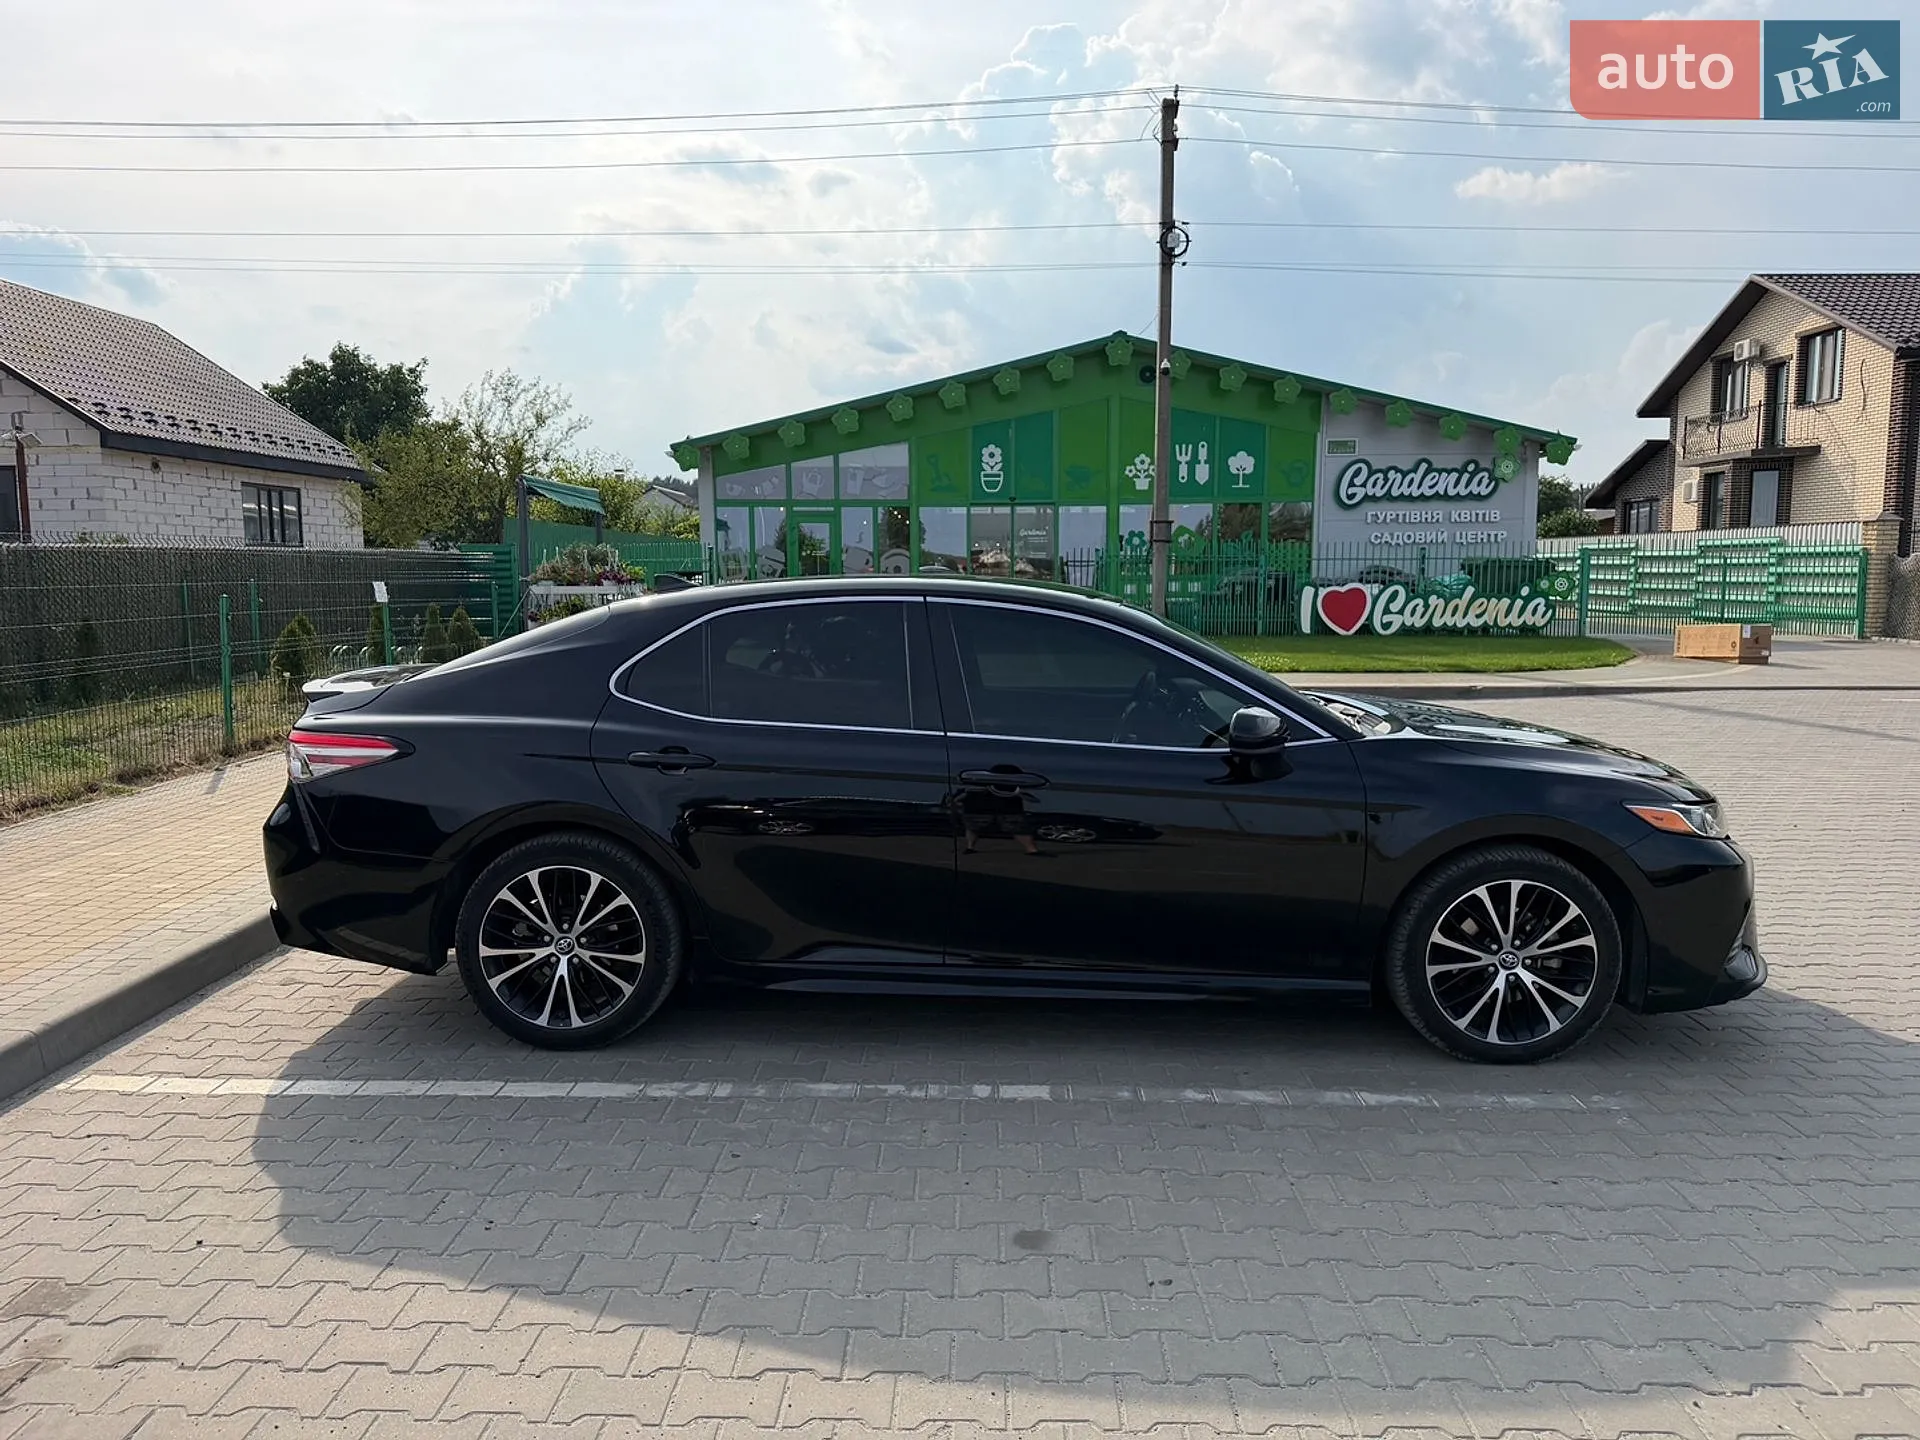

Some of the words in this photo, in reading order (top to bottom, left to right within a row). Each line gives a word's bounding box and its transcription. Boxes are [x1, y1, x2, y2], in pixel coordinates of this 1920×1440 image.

[1339, 462, 1495, 505] Gardenia
[1366, 510, 1444, 524] ГУРТІВНЯ
[1450, 509, 1501, 523] КВІТІВ
[1370, 529, 1448, 545] САДОВИЙ
[1455, 530, 1508, 545] ЦЕНТР
[1301, 585, 1316, 634] I
[1373, 585, 1553, 636] Gardenia
